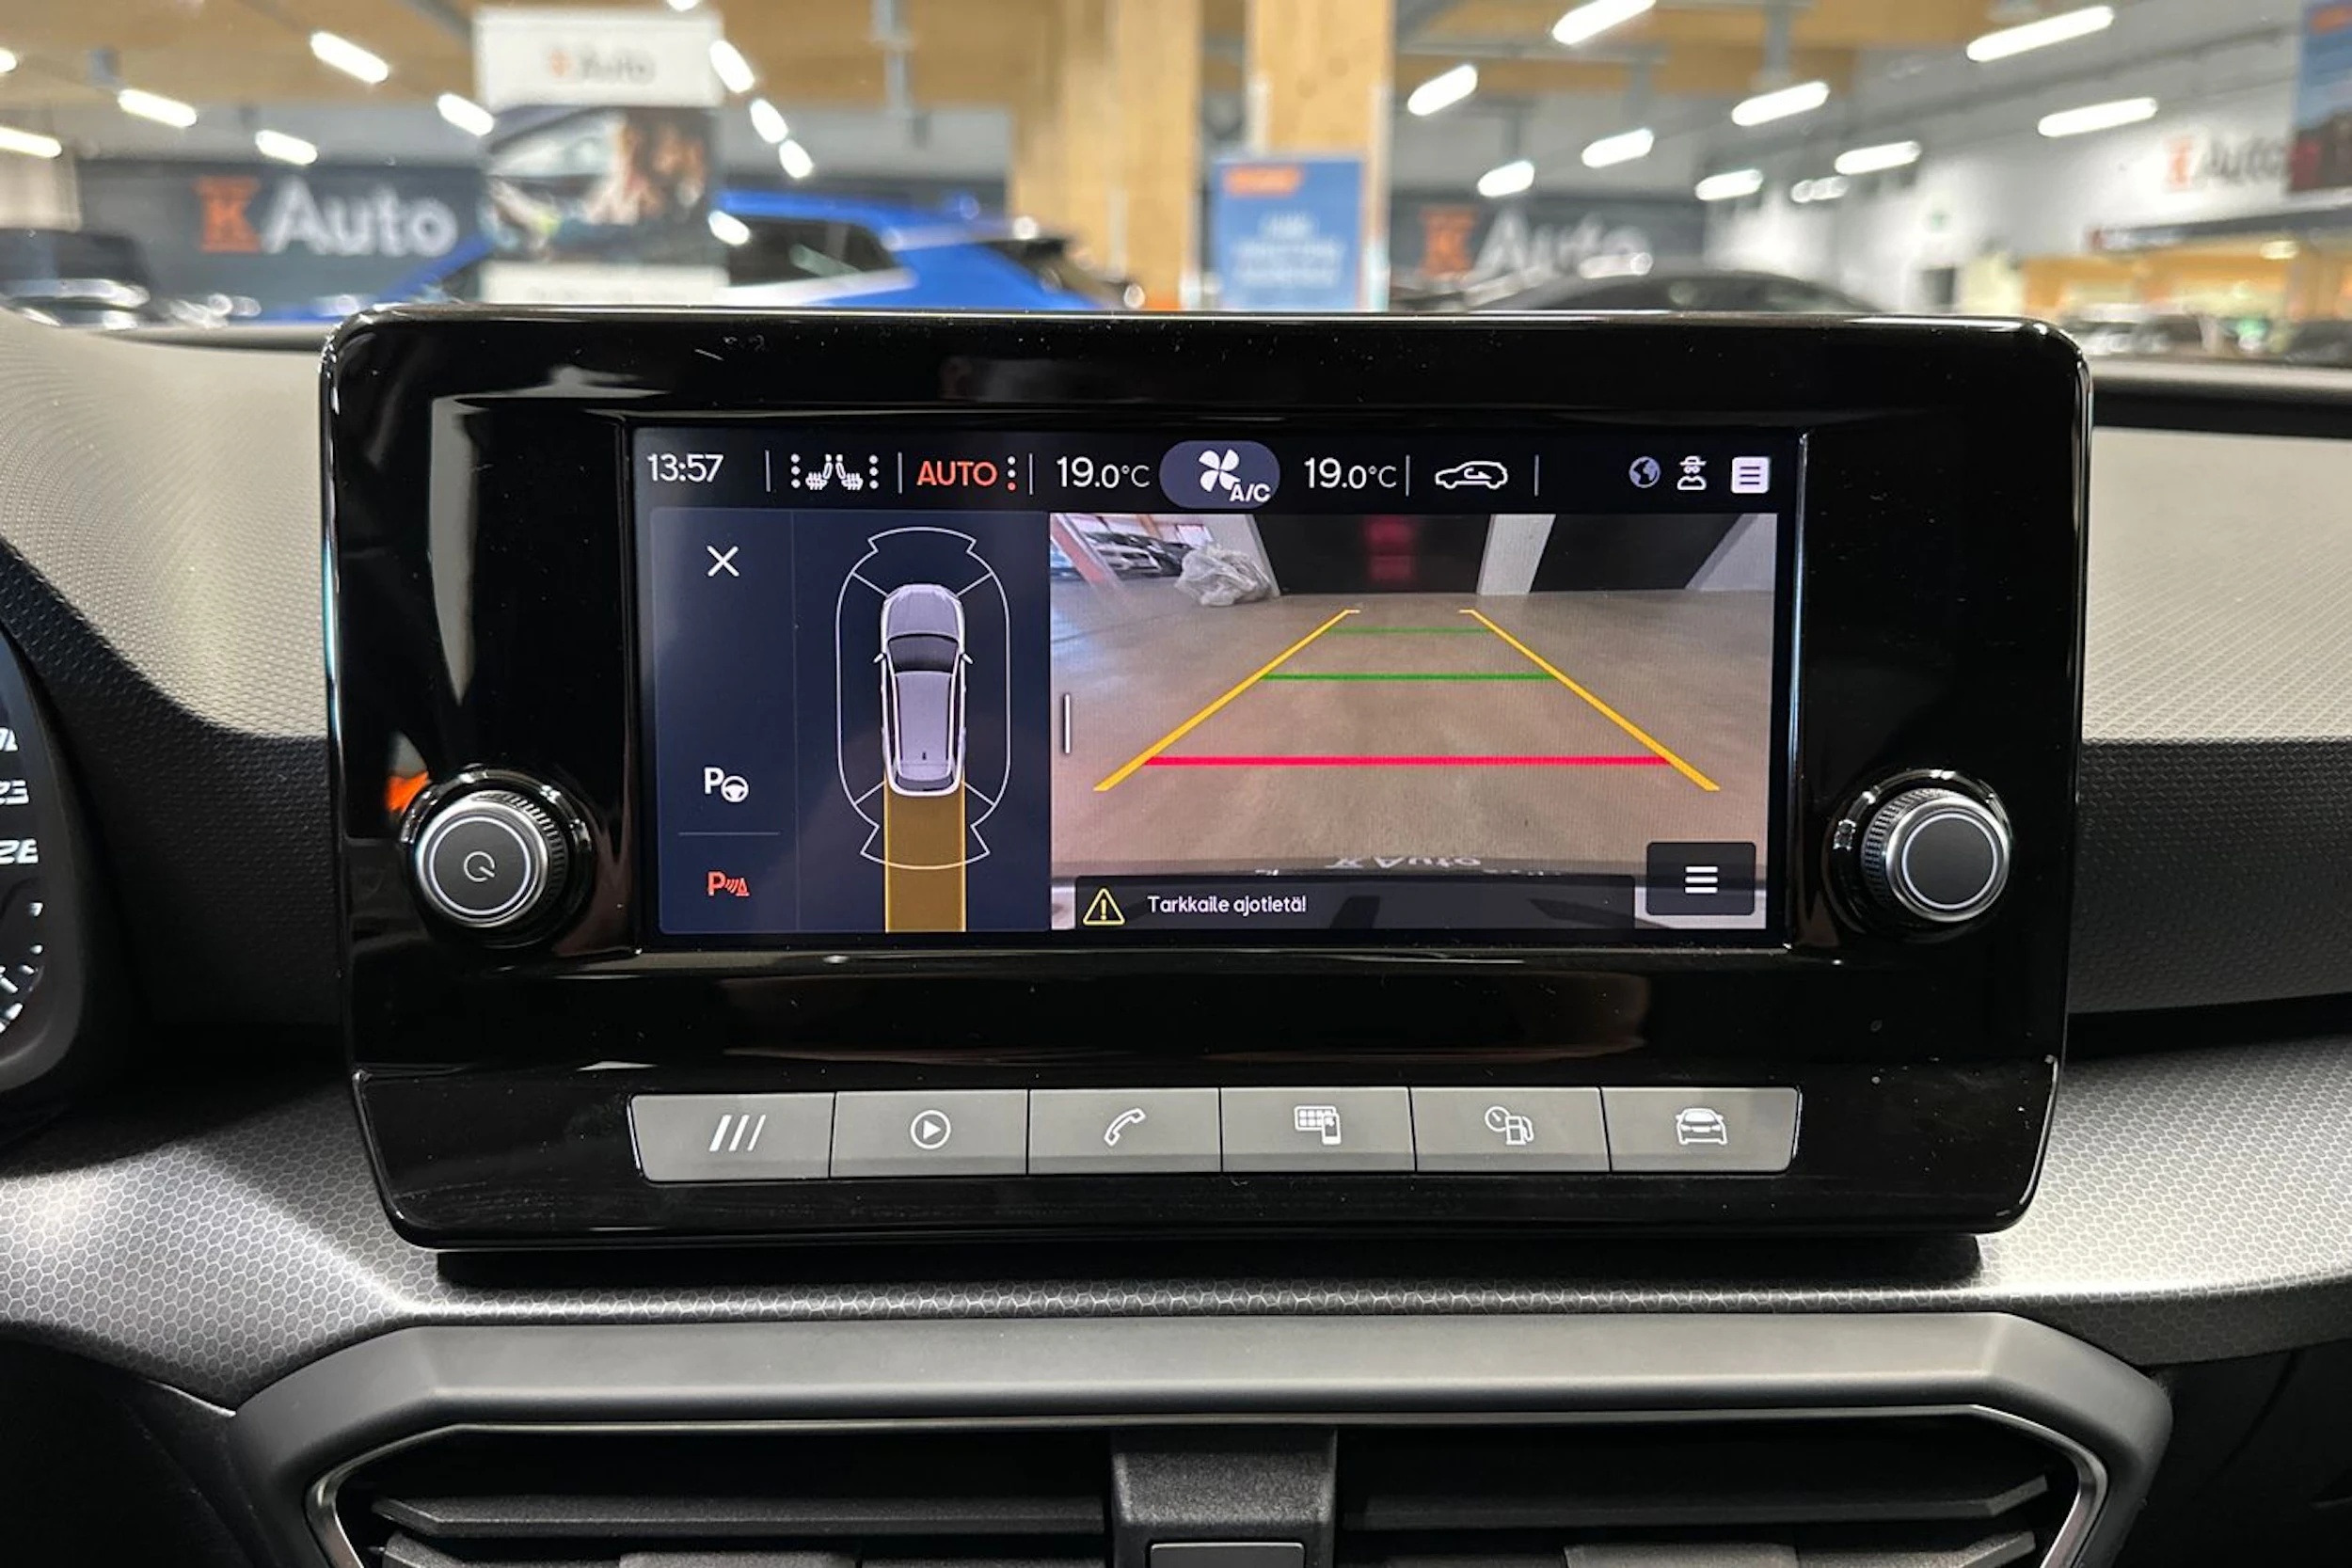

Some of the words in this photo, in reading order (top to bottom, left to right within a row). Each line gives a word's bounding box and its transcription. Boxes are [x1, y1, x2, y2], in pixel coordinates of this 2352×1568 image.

[261, 176, 458, 257] Auto
[647, 453, 724, 483] 13:57
[916, 460, 998, 486] AUTO
[1057, 456, 1151, 488] 19.0°C
[1304, 457, 1397, 489] 19.0°C
[1230, 483, 1271, 503] A/C
[1147, 895, 1230, 913] Tarkkaile
[1233, 895, 1308, 917] ajotietä!
